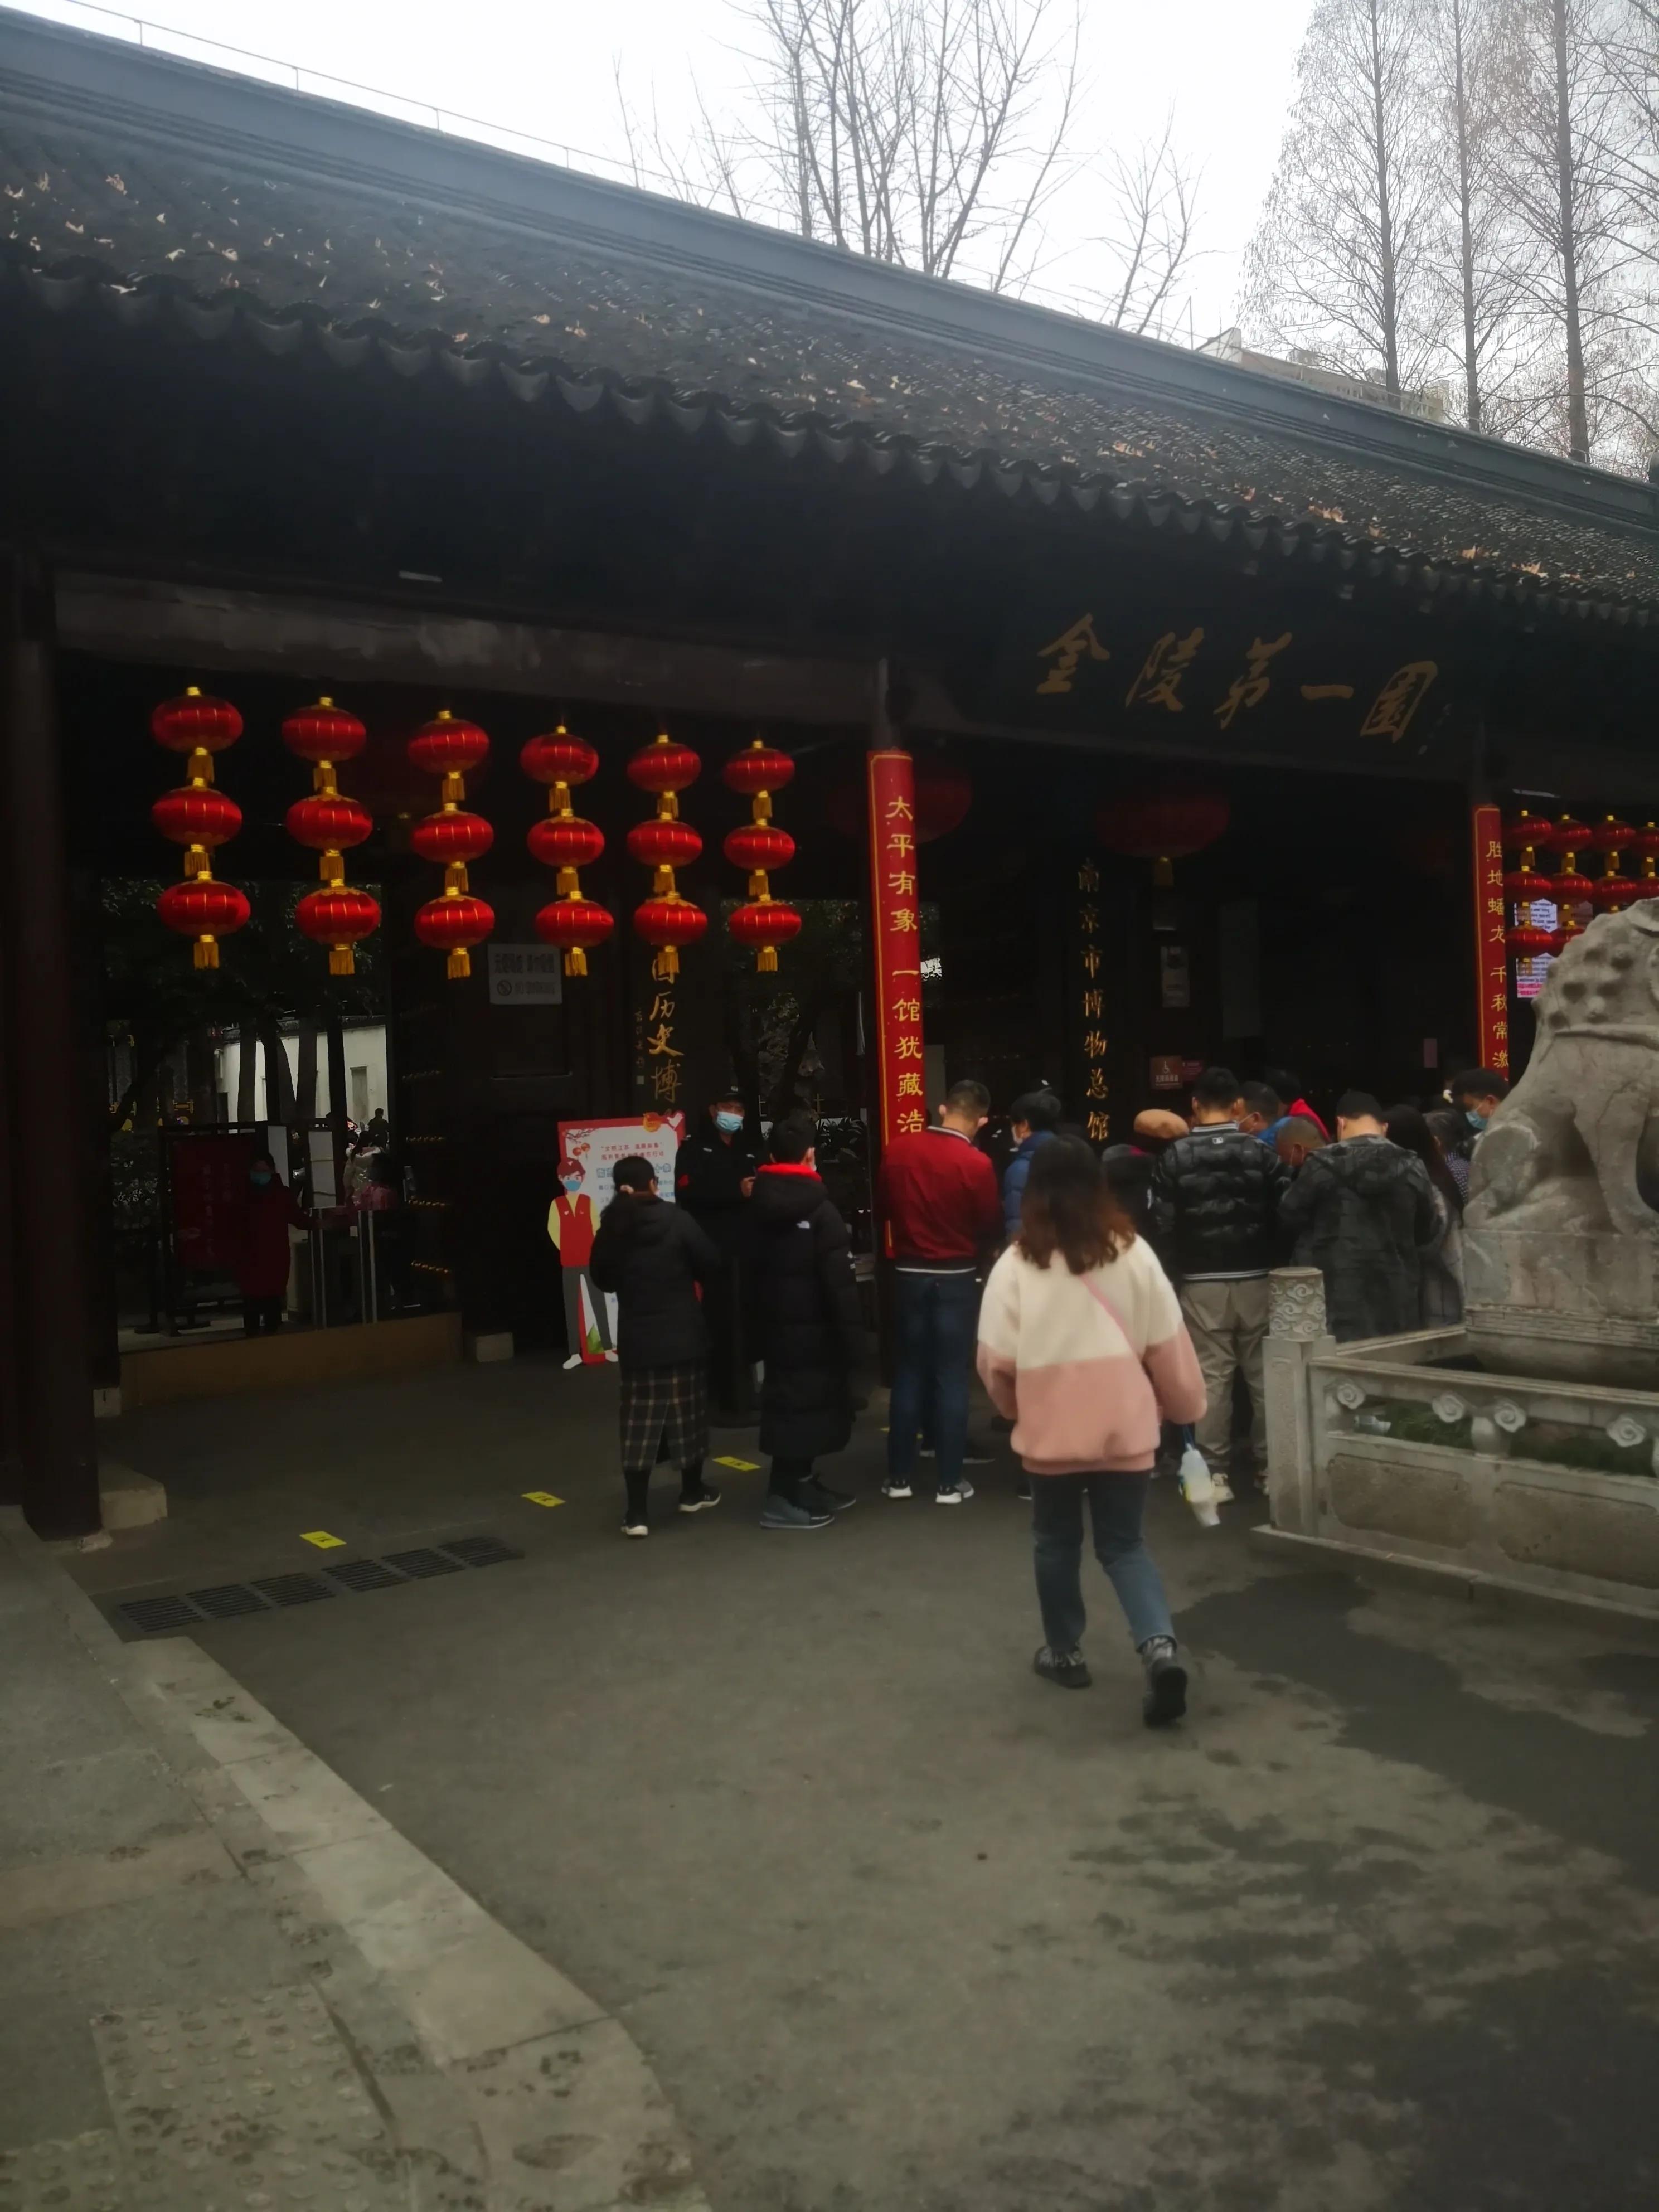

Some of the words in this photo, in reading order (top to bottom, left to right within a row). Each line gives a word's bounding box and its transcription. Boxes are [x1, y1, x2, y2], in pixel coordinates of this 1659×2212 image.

[647, 955, 685, 1112] 历史博
[1078, 857, 1110, 1142] 南京市博物总馆
[1486, 841, 1509, 1081] 胜地蟠龙千秋常激
